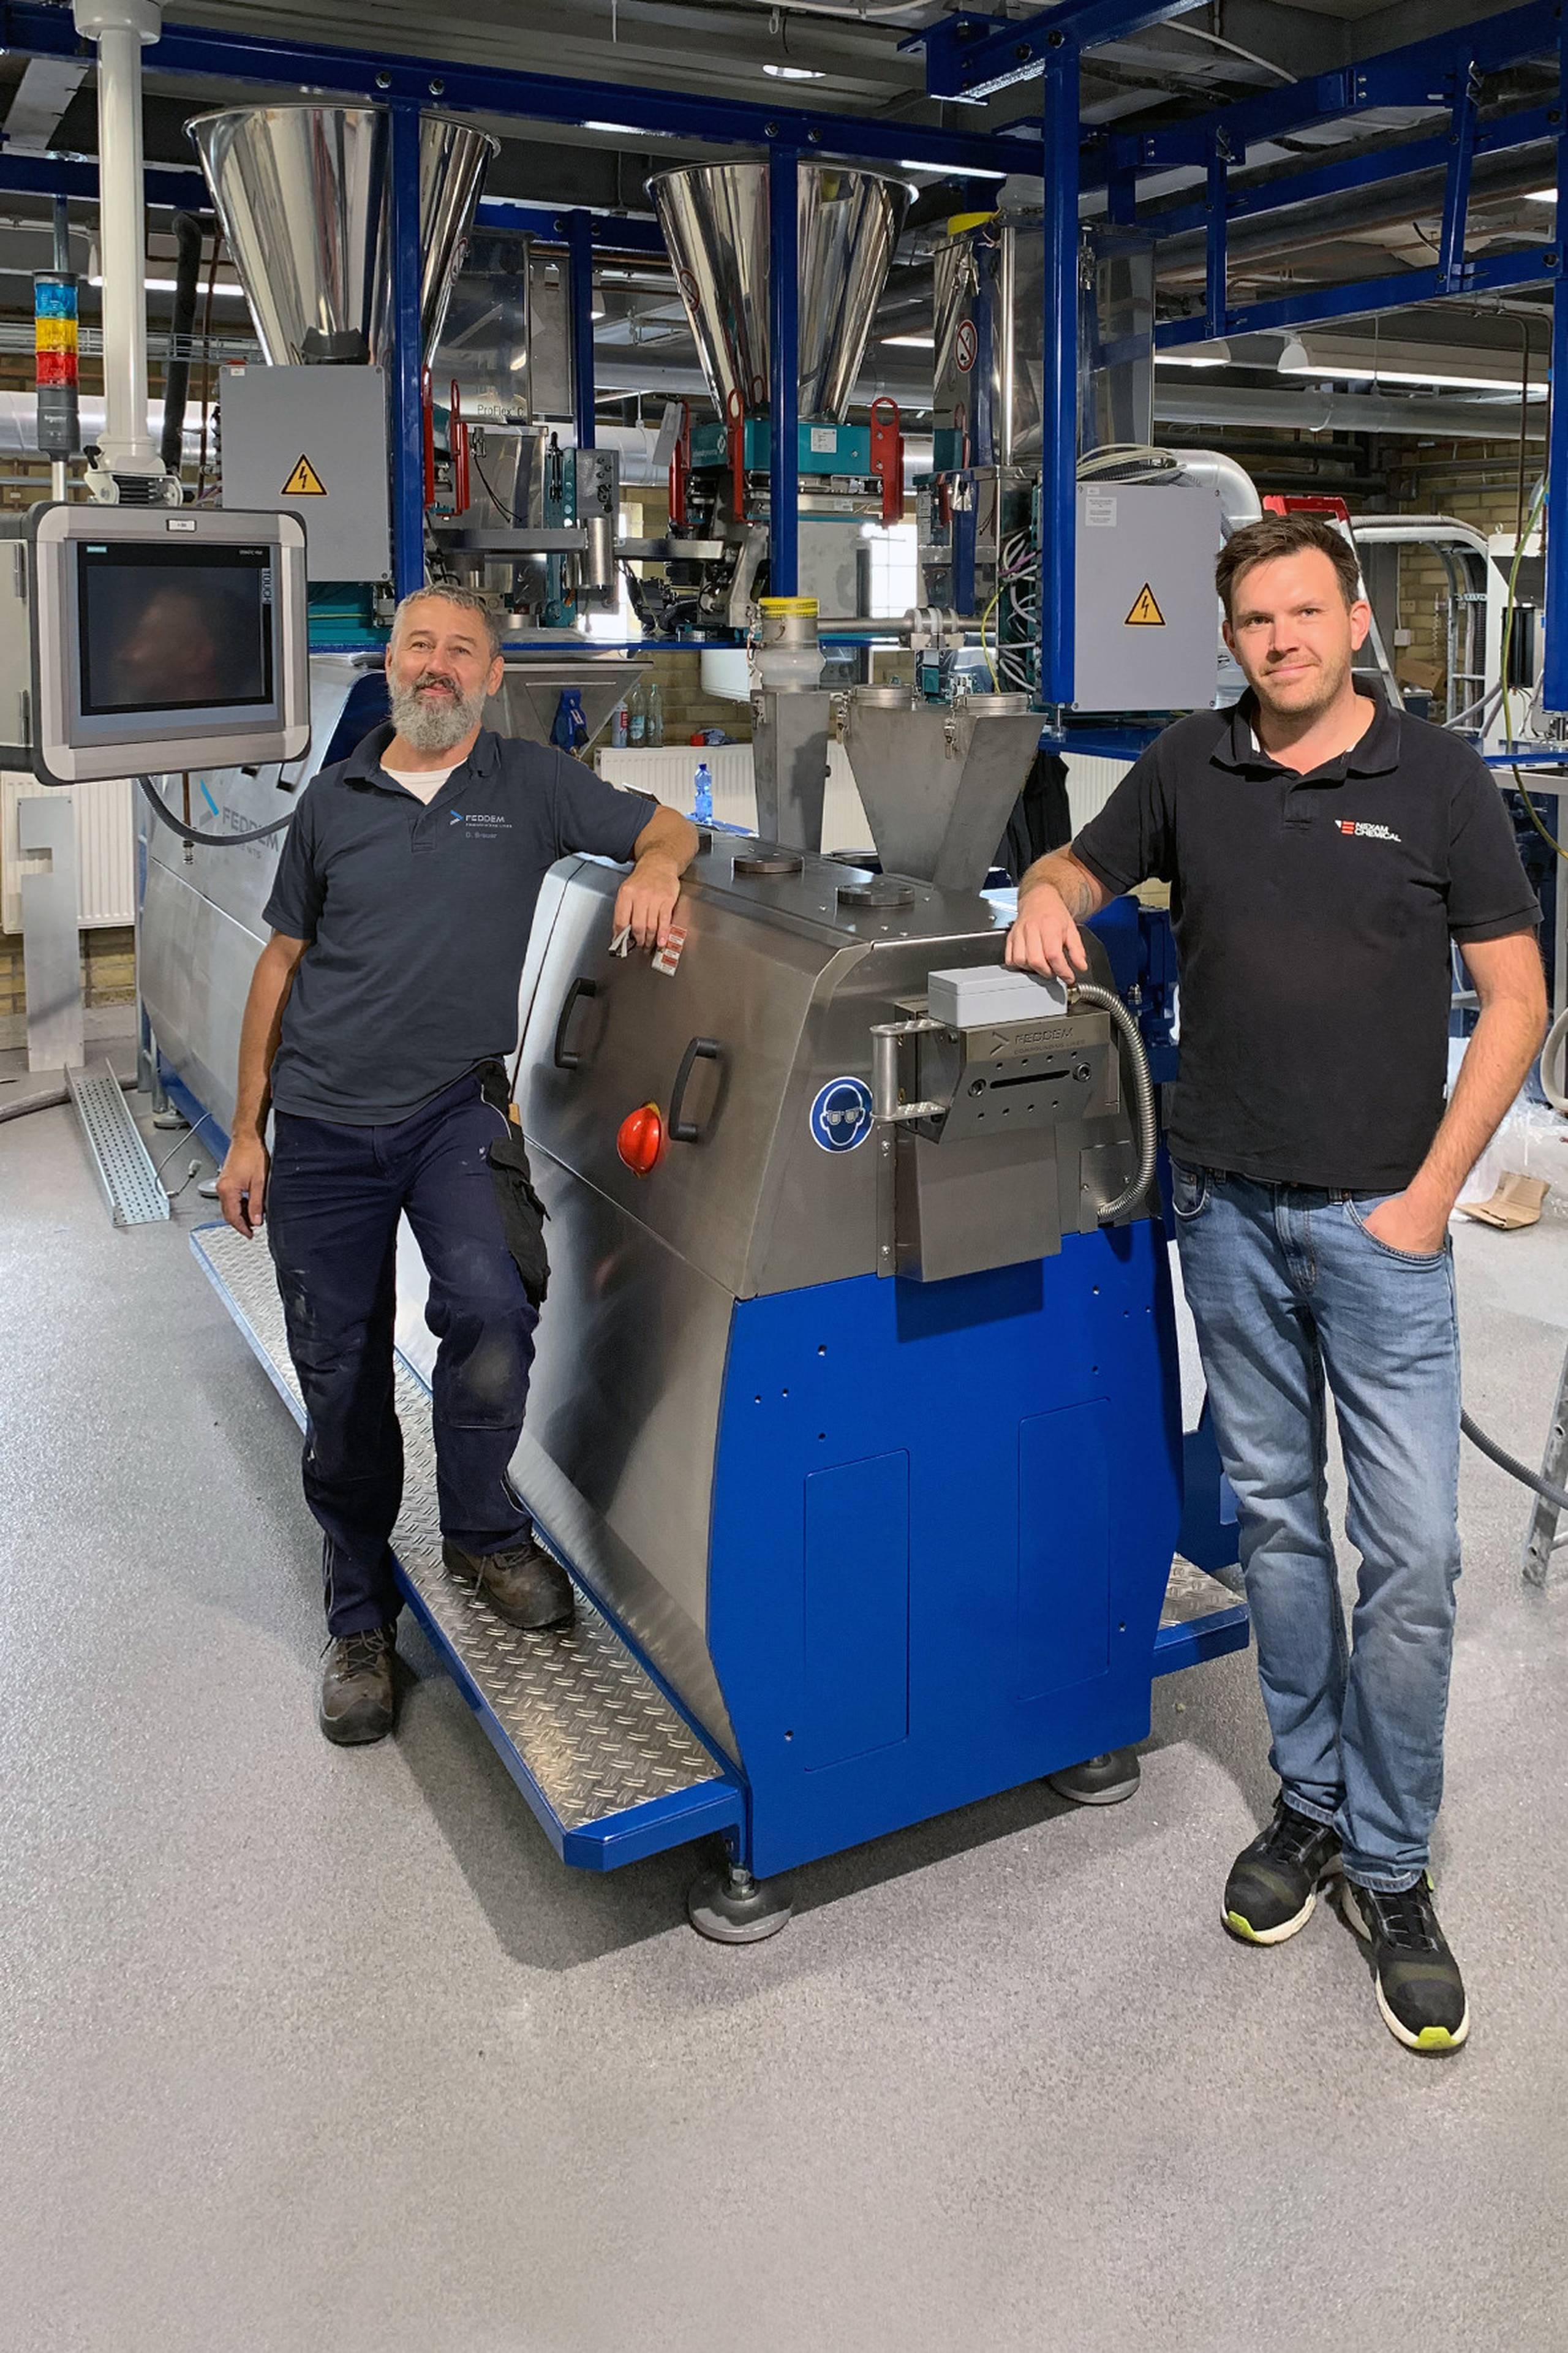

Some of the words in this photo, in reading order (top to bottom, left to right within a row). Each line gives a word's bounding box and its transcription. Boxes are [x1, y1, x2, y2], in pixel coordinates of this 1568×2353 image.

[262, 570, 272, 603] TOUCH
[222, 806, 279, 852] FEDDM
[1355, 821, 1389, 834] NEXAM
[1016, 1027, 1073, 1044] FEDDEM
